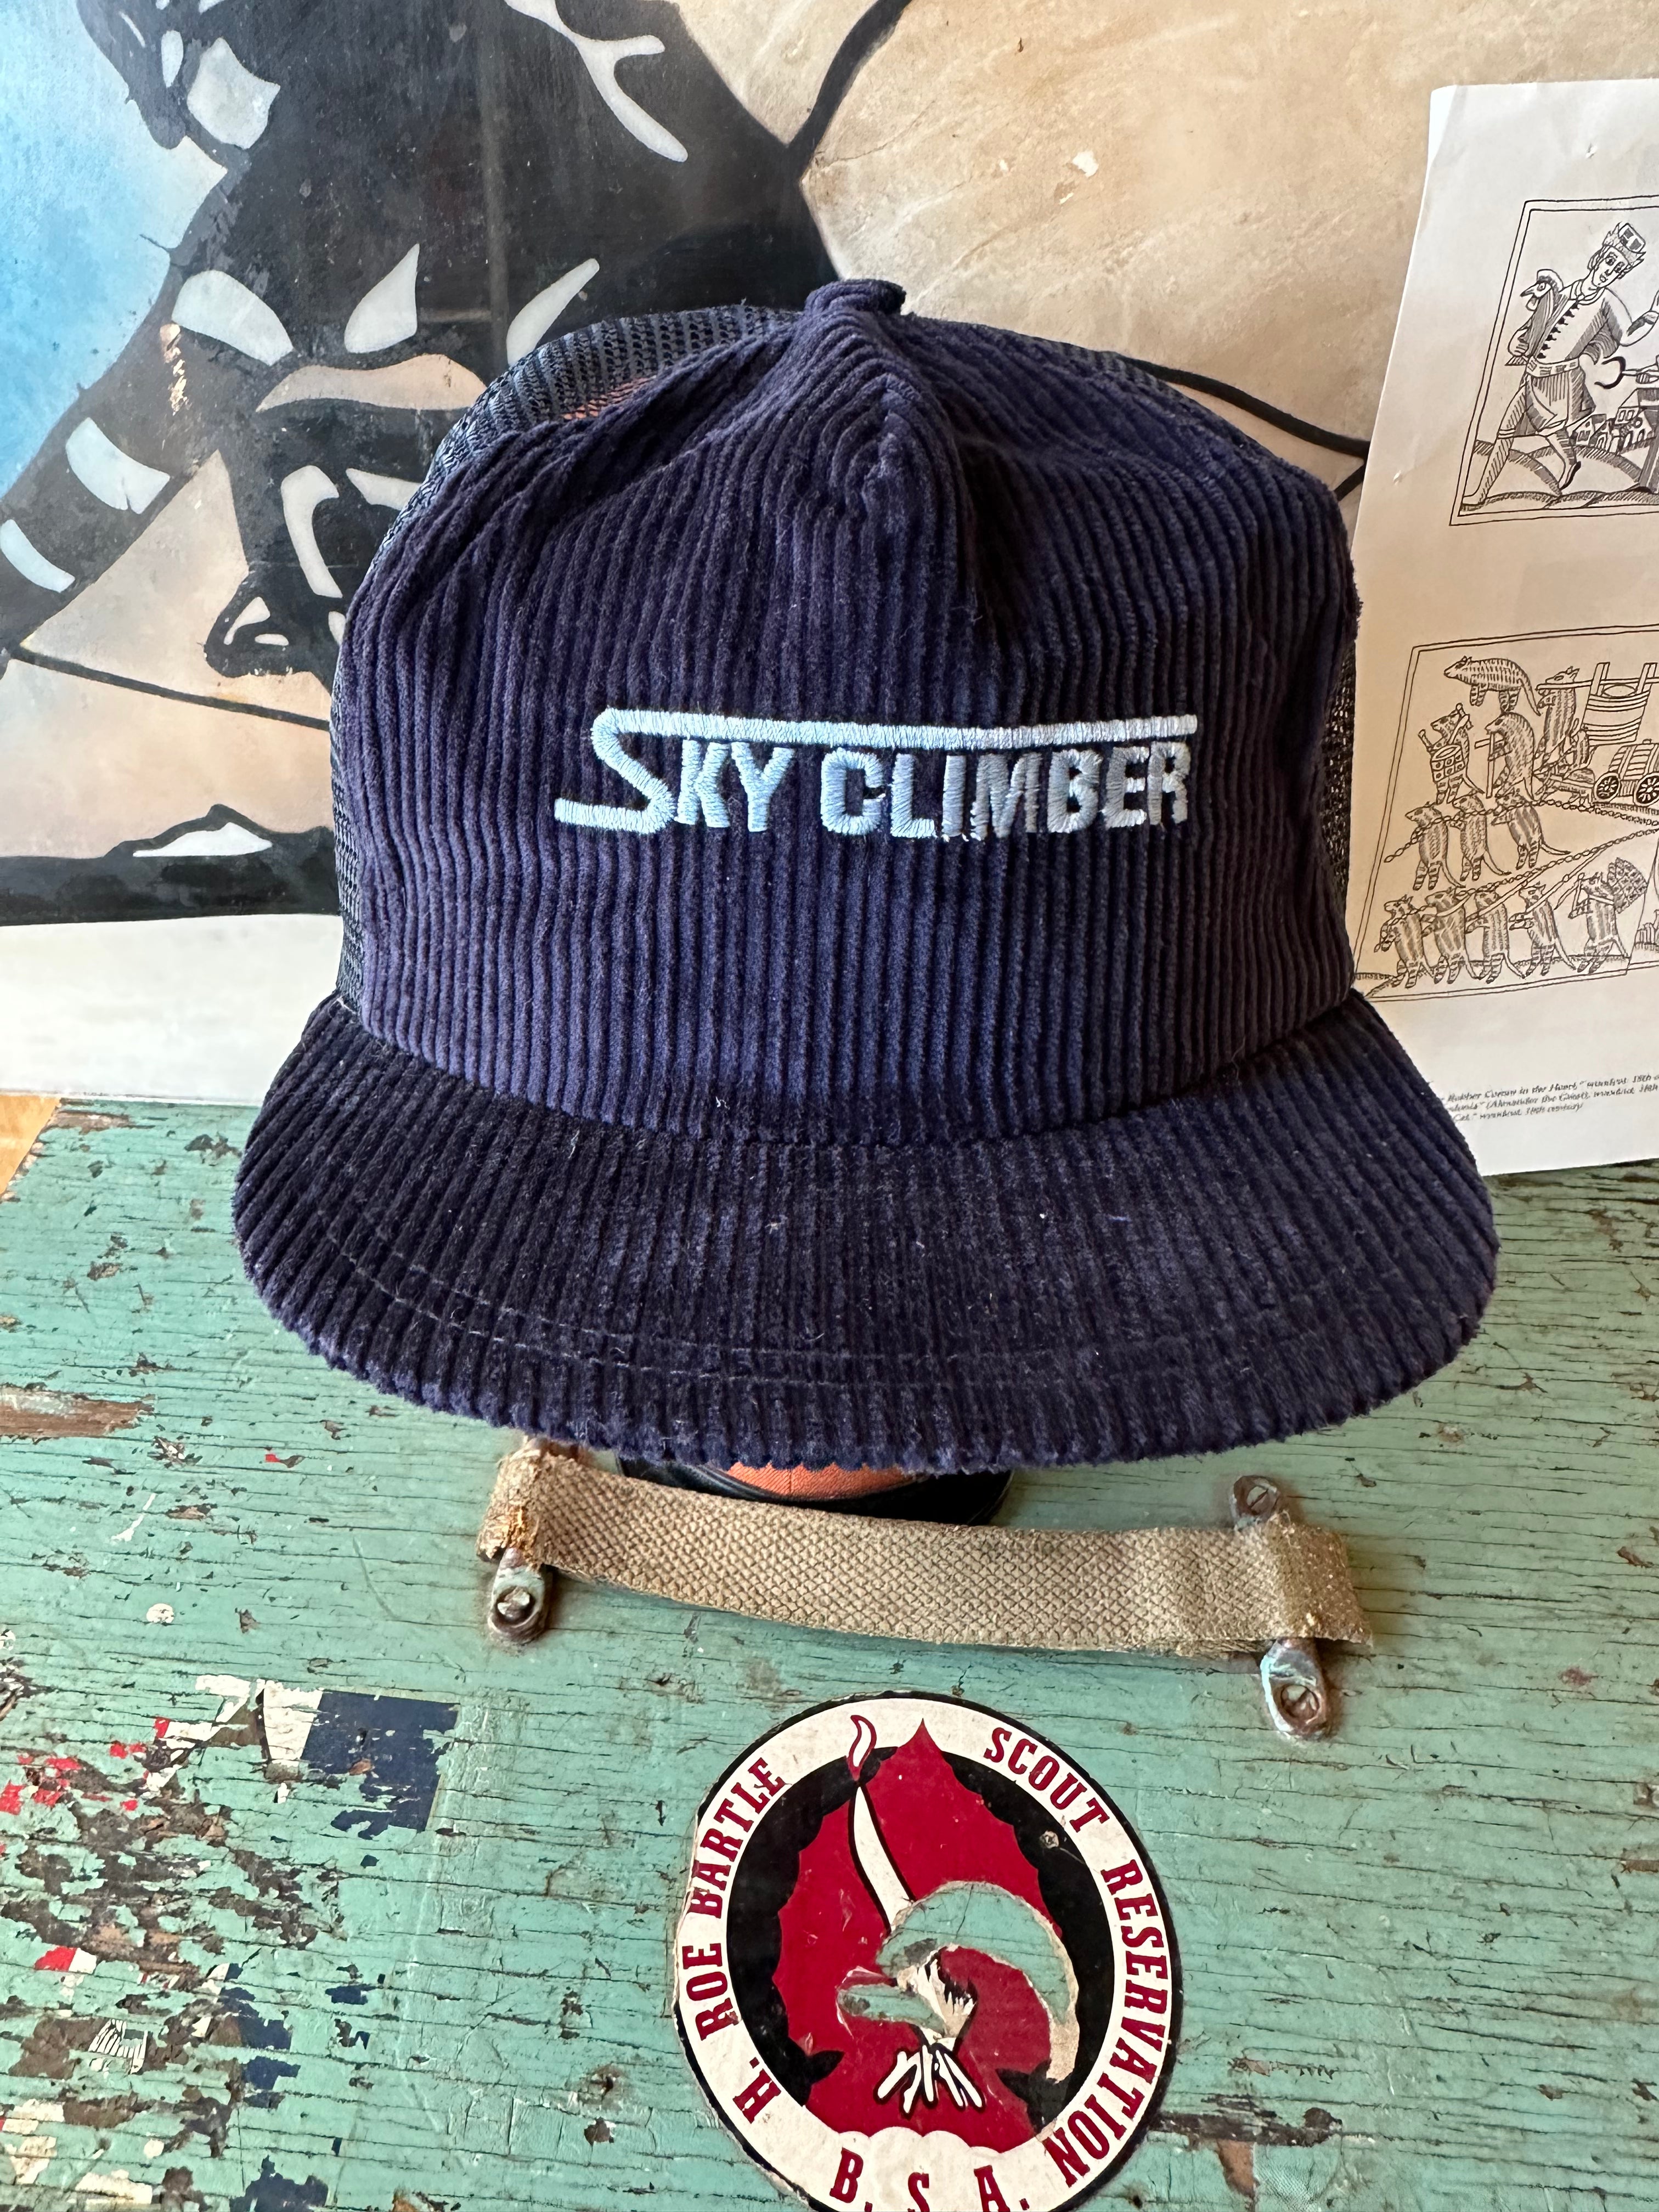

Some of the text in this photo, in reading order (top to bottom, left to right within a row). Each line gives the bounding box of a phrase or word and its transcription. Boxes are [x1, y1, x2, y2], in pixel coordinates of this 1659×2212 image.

[554, 707, 1192, 841] SKY CLIMBER
[681, 1757, 791, 2124] H. ROE BARTLE
[983, 1726, 1169, 2188] SCOUT RESERVATION
[829, 2147, 873, 2212] B.
[974, 2164, 1030, 2212] A.
